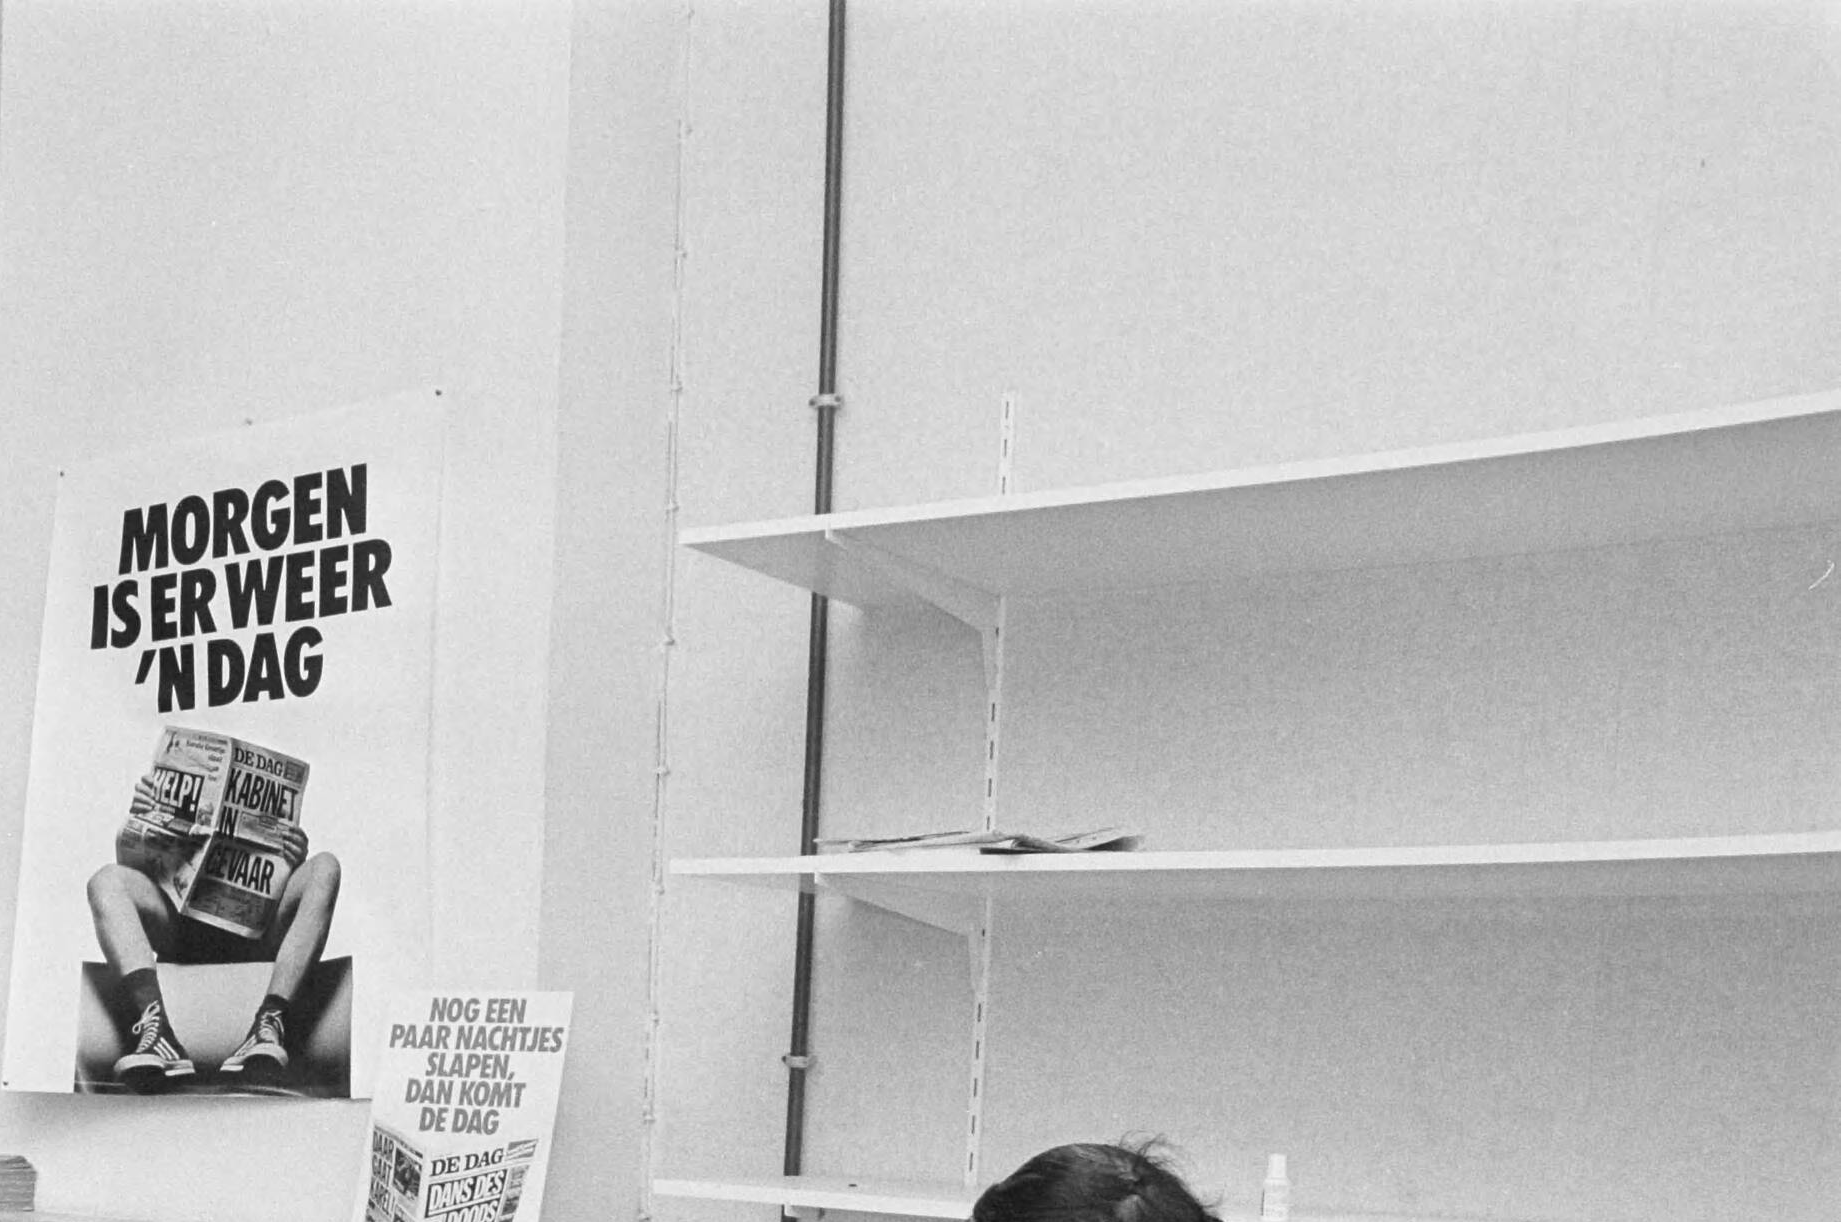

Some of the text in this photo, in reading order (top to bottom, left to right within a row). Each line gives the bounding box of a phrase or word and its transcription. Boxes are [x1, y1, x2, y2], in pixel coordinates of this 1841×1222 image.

[119, 464, 366, 575] MORGEN
[91, 539, 391, 649] IS ER WEER
[208, 626, 323, 707] DAG
[234, 747, 255, 767] DE
[256, 756, 284, 778] DAG
[225, 767, 299, 821] KABINET
[219, 805, 239, 839] IN
[430, 997, 527, 1024] NOG EEN
[389, 1024, 564, 1053] PAAR NACHTJES
[425, 1052, 515, 1080] SLAPEN,
[405, 1078, 526, 1108] DAN KOMT
[419, 1106, 500, 1135] DE DAG
[429, 1156, 460, 1177] DE
[465, 1148, 504, 1171] DAG
[429, 1177, 474, 1212] DANS
[474, 1170, 505, 1199] DES
